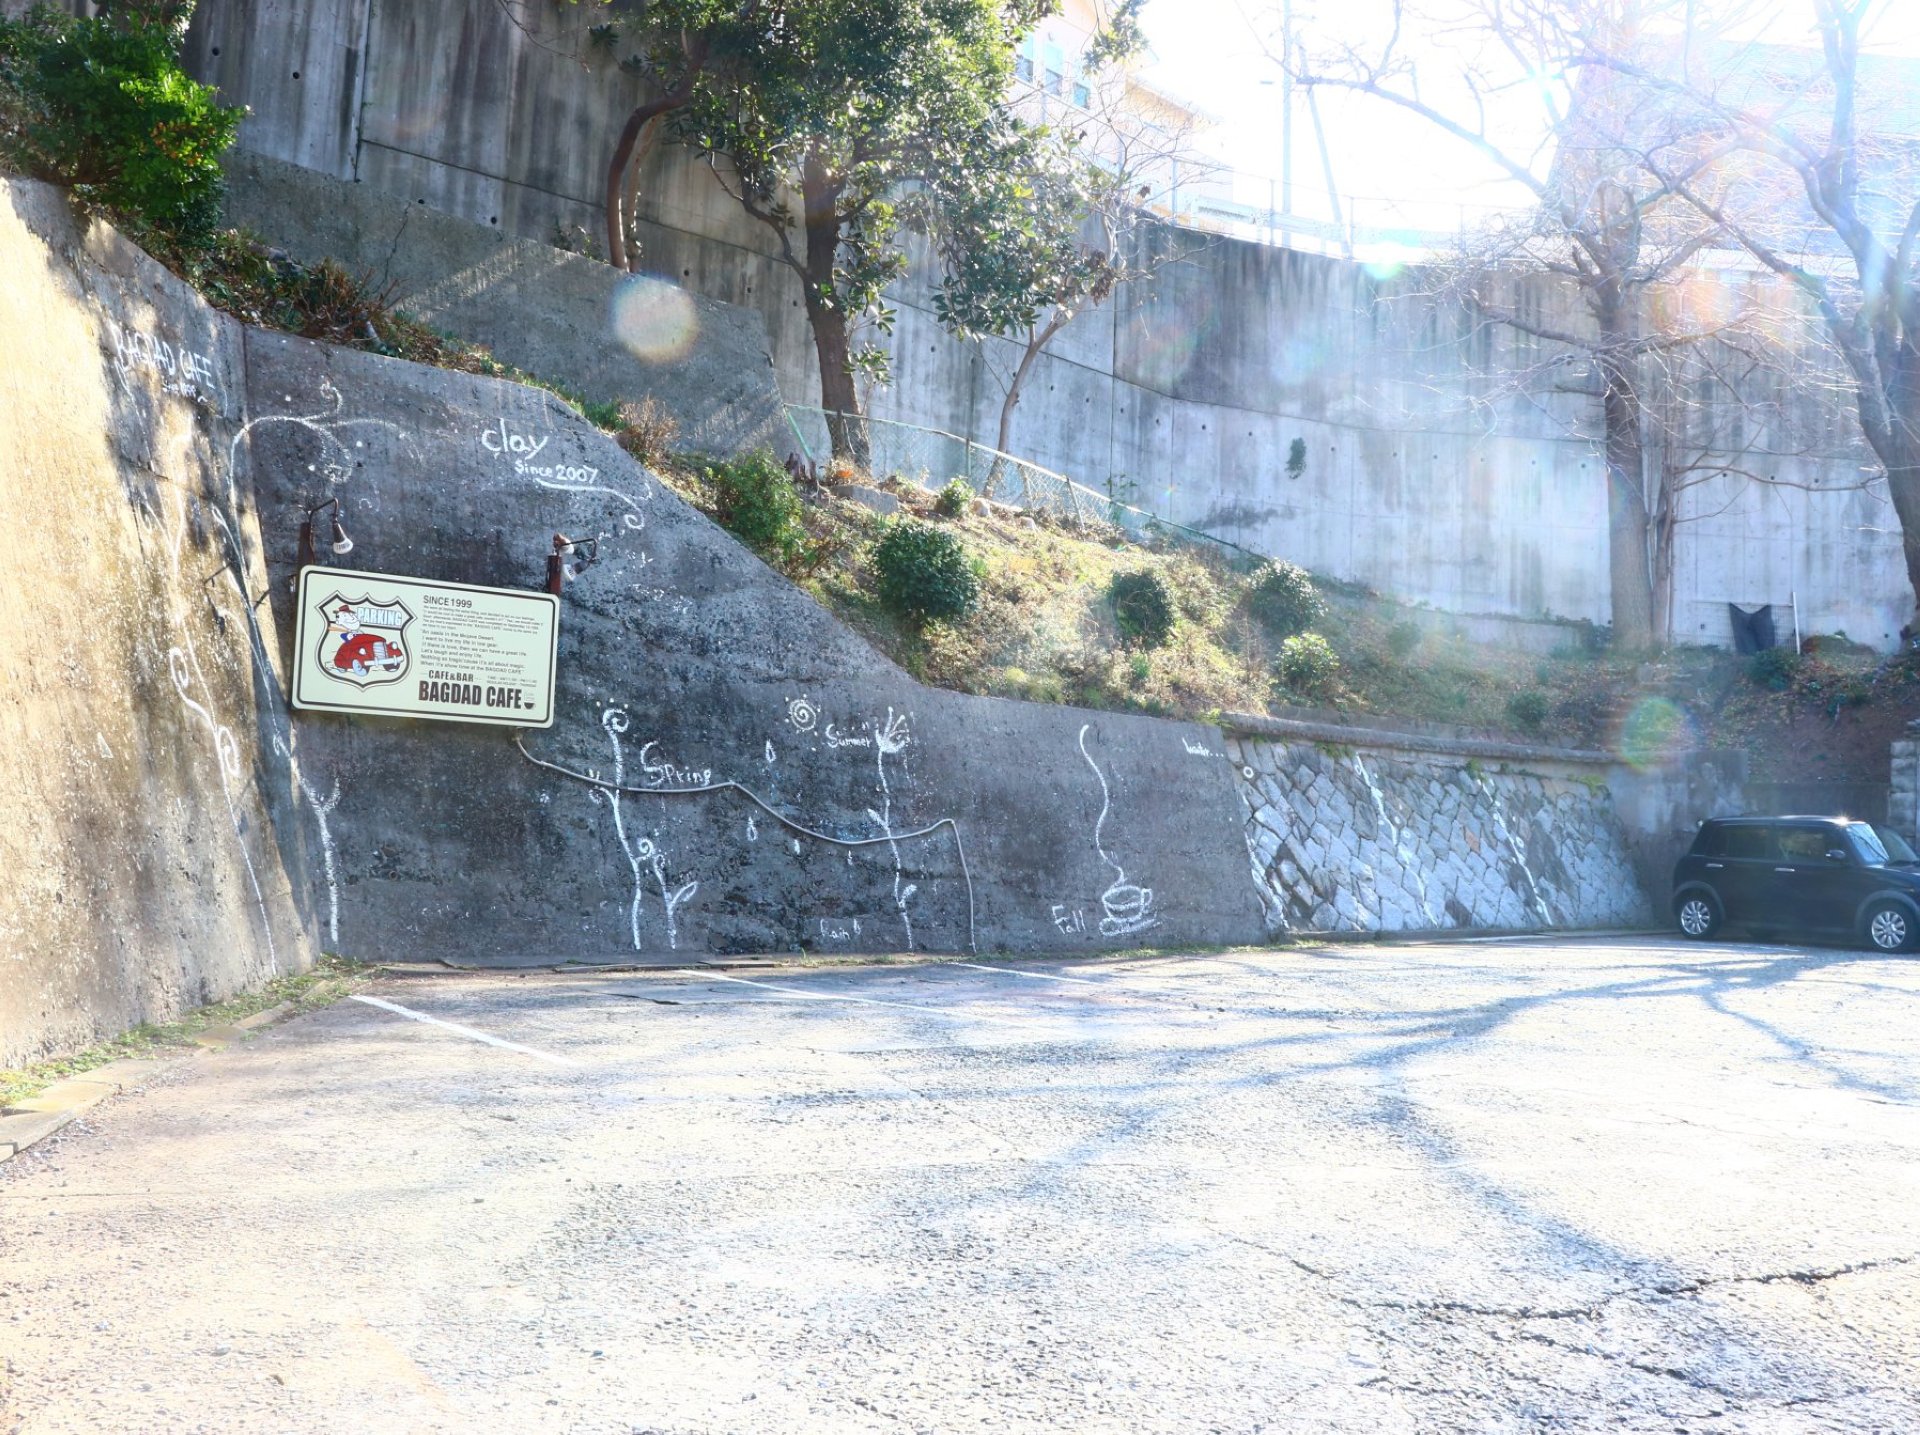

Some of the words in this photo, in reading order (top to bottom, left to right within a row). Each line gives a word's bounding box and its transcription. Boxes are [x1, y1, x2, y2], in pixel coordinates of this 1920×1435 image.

[180, 348, 216, 390] CAFE
[555, 464, 599, 484] 2007
[422, 595, 449, 606] SINCE
[450, 598, 472, 609] 1999
[357, 606, 402, 626] PARKING
[428, 669, 474, 682] CAFE&BAR
[418, 680, 482, 706] BAGDAD
[486, 686, 522, 709] CAFE
[640, 741, 712, 786] Spring
[1051, 903, 1086, 935] Fall
